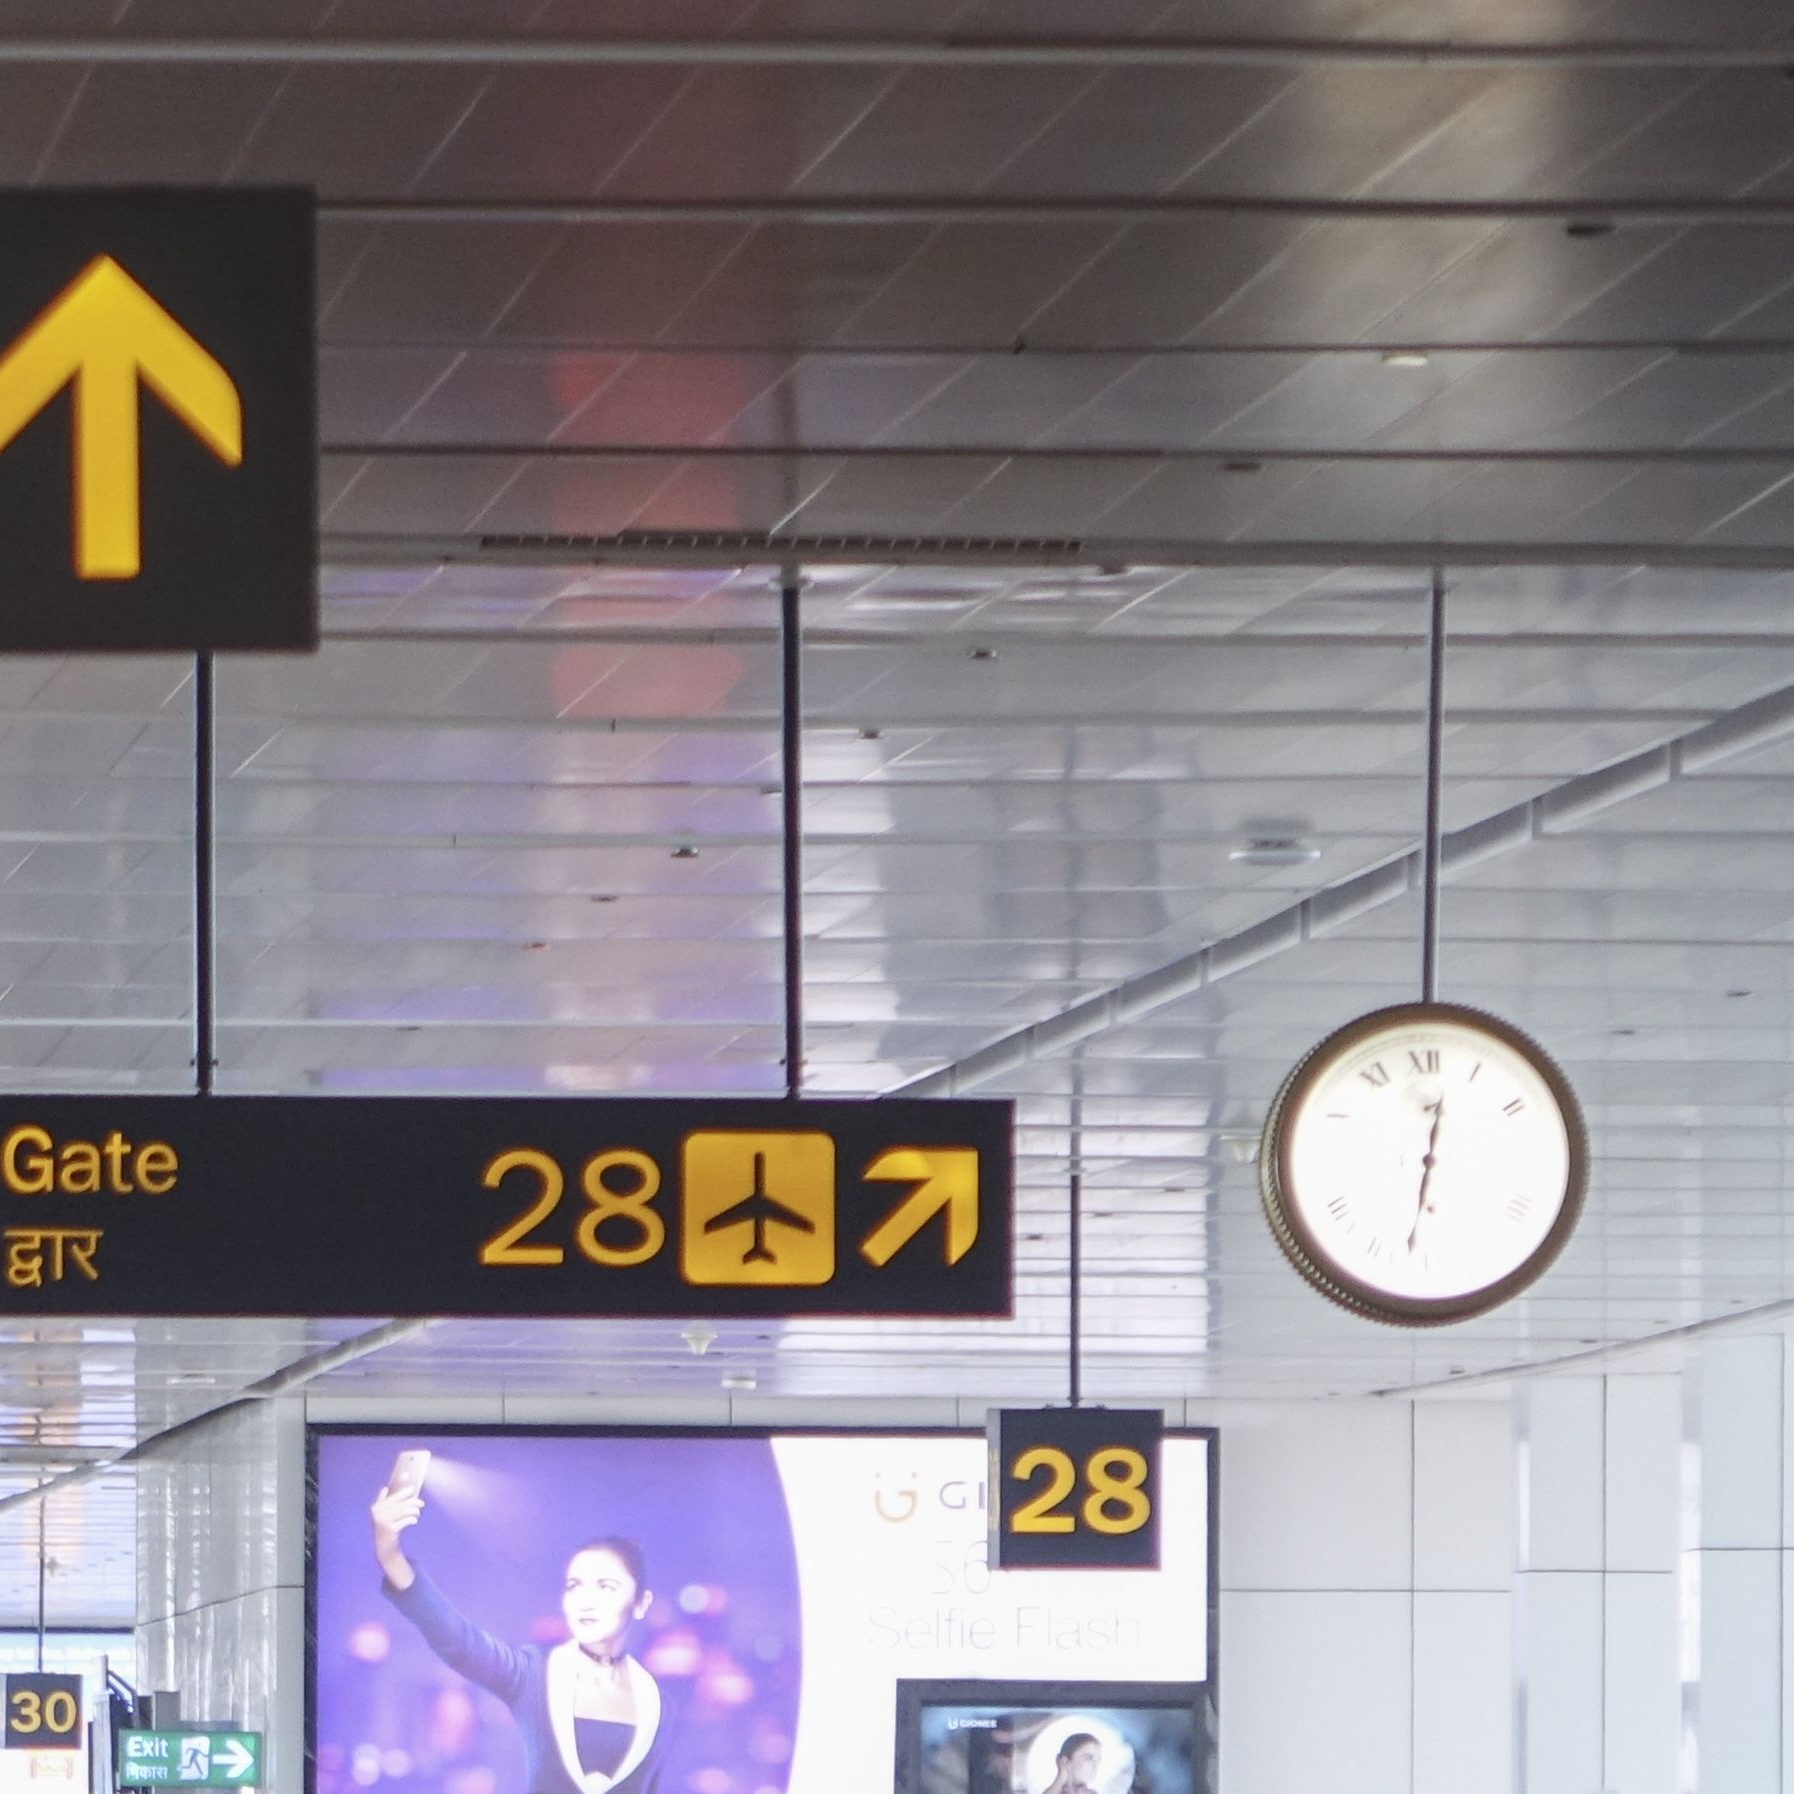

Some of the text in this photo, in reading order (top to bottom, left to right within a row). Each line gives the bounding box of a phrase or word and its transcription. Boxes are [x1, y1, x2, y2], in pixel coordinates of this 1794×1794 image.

[3, 1125, 664, 1266] Gate 28
[6, 1229, 103, 1286] द्वार
[1012, 1448, 1150, 1533] 28
[869, 1606, 1140, 1650] Selfie Flash
[11, 1691, 77, 1733] 30
[126, 1735, 169, 1758] Exit
